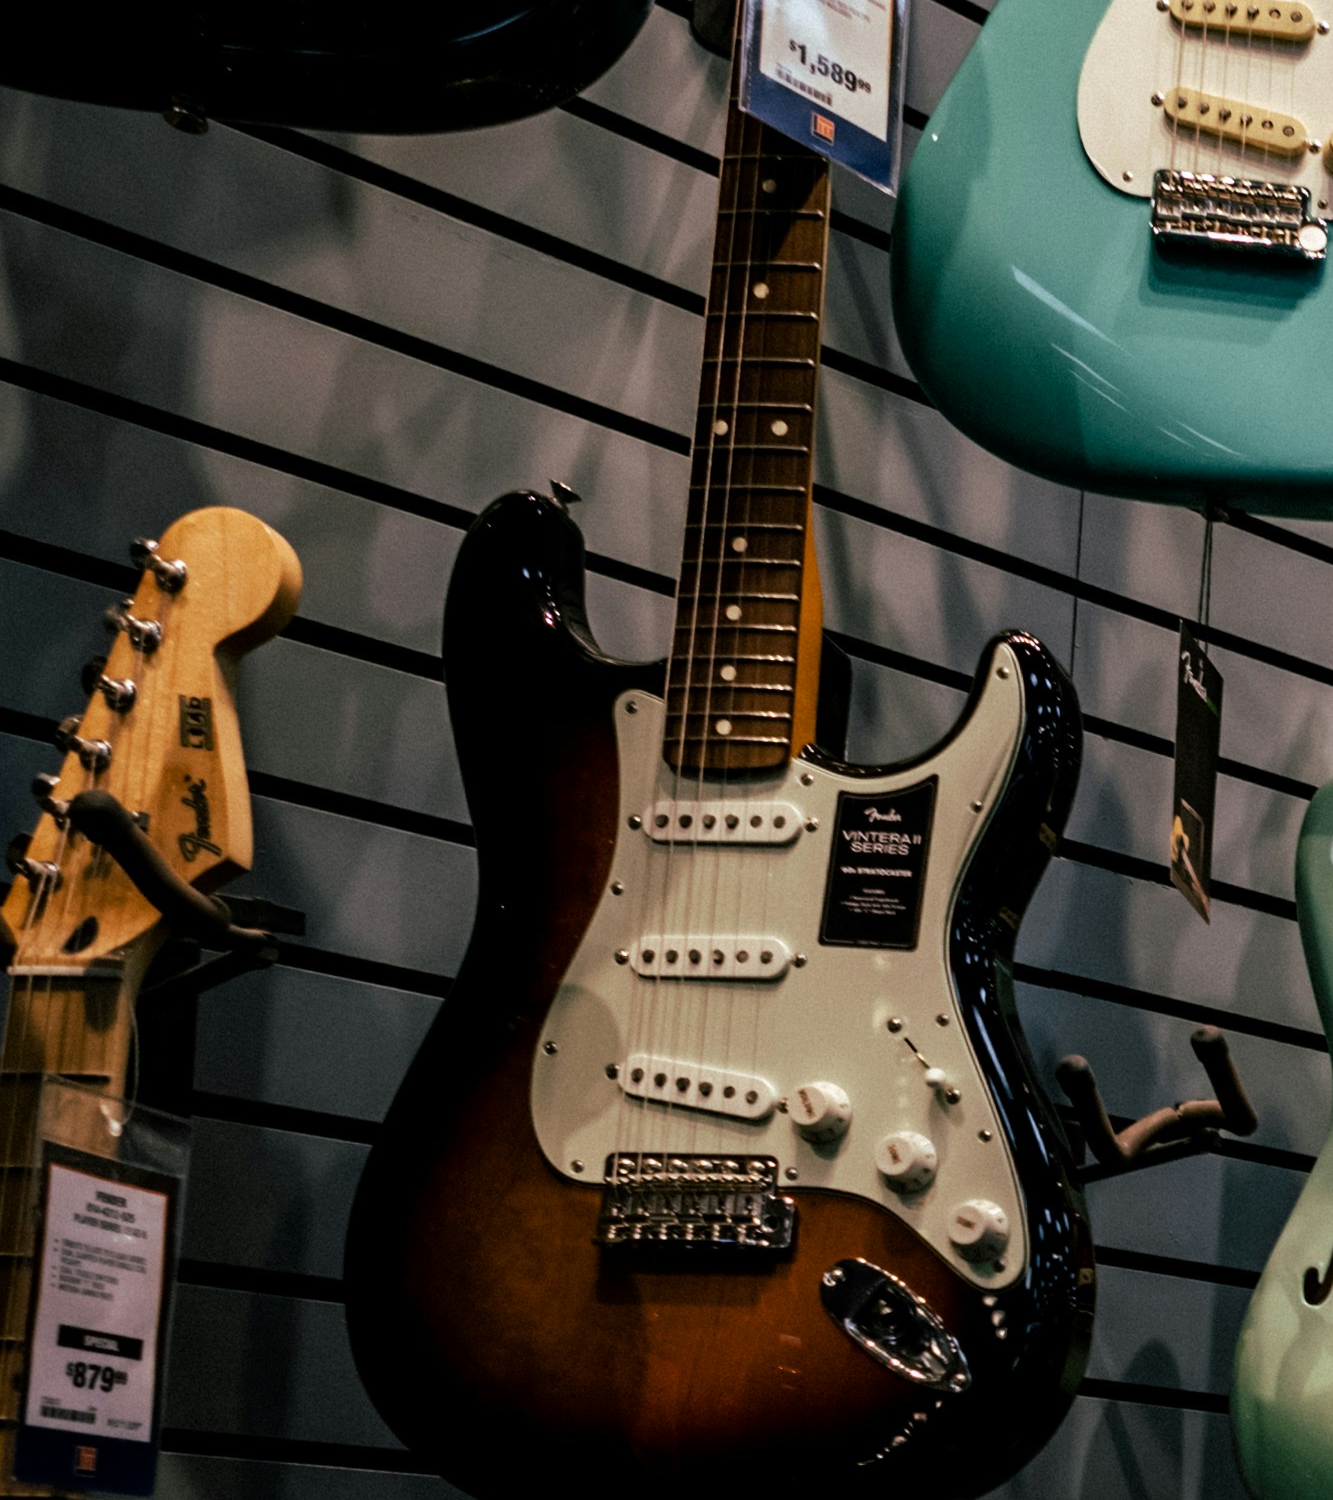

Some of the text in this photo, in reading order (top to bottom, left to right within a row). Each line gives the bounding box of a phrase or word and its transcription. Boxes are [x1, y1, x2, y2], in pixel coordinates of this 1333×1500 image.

[178, 778, 223, 863] Fender
[864, 807, 902, 823] Fender
[842, 830, 922, 845] VINTERA II
[850, 841, 910, 856] SERIES
